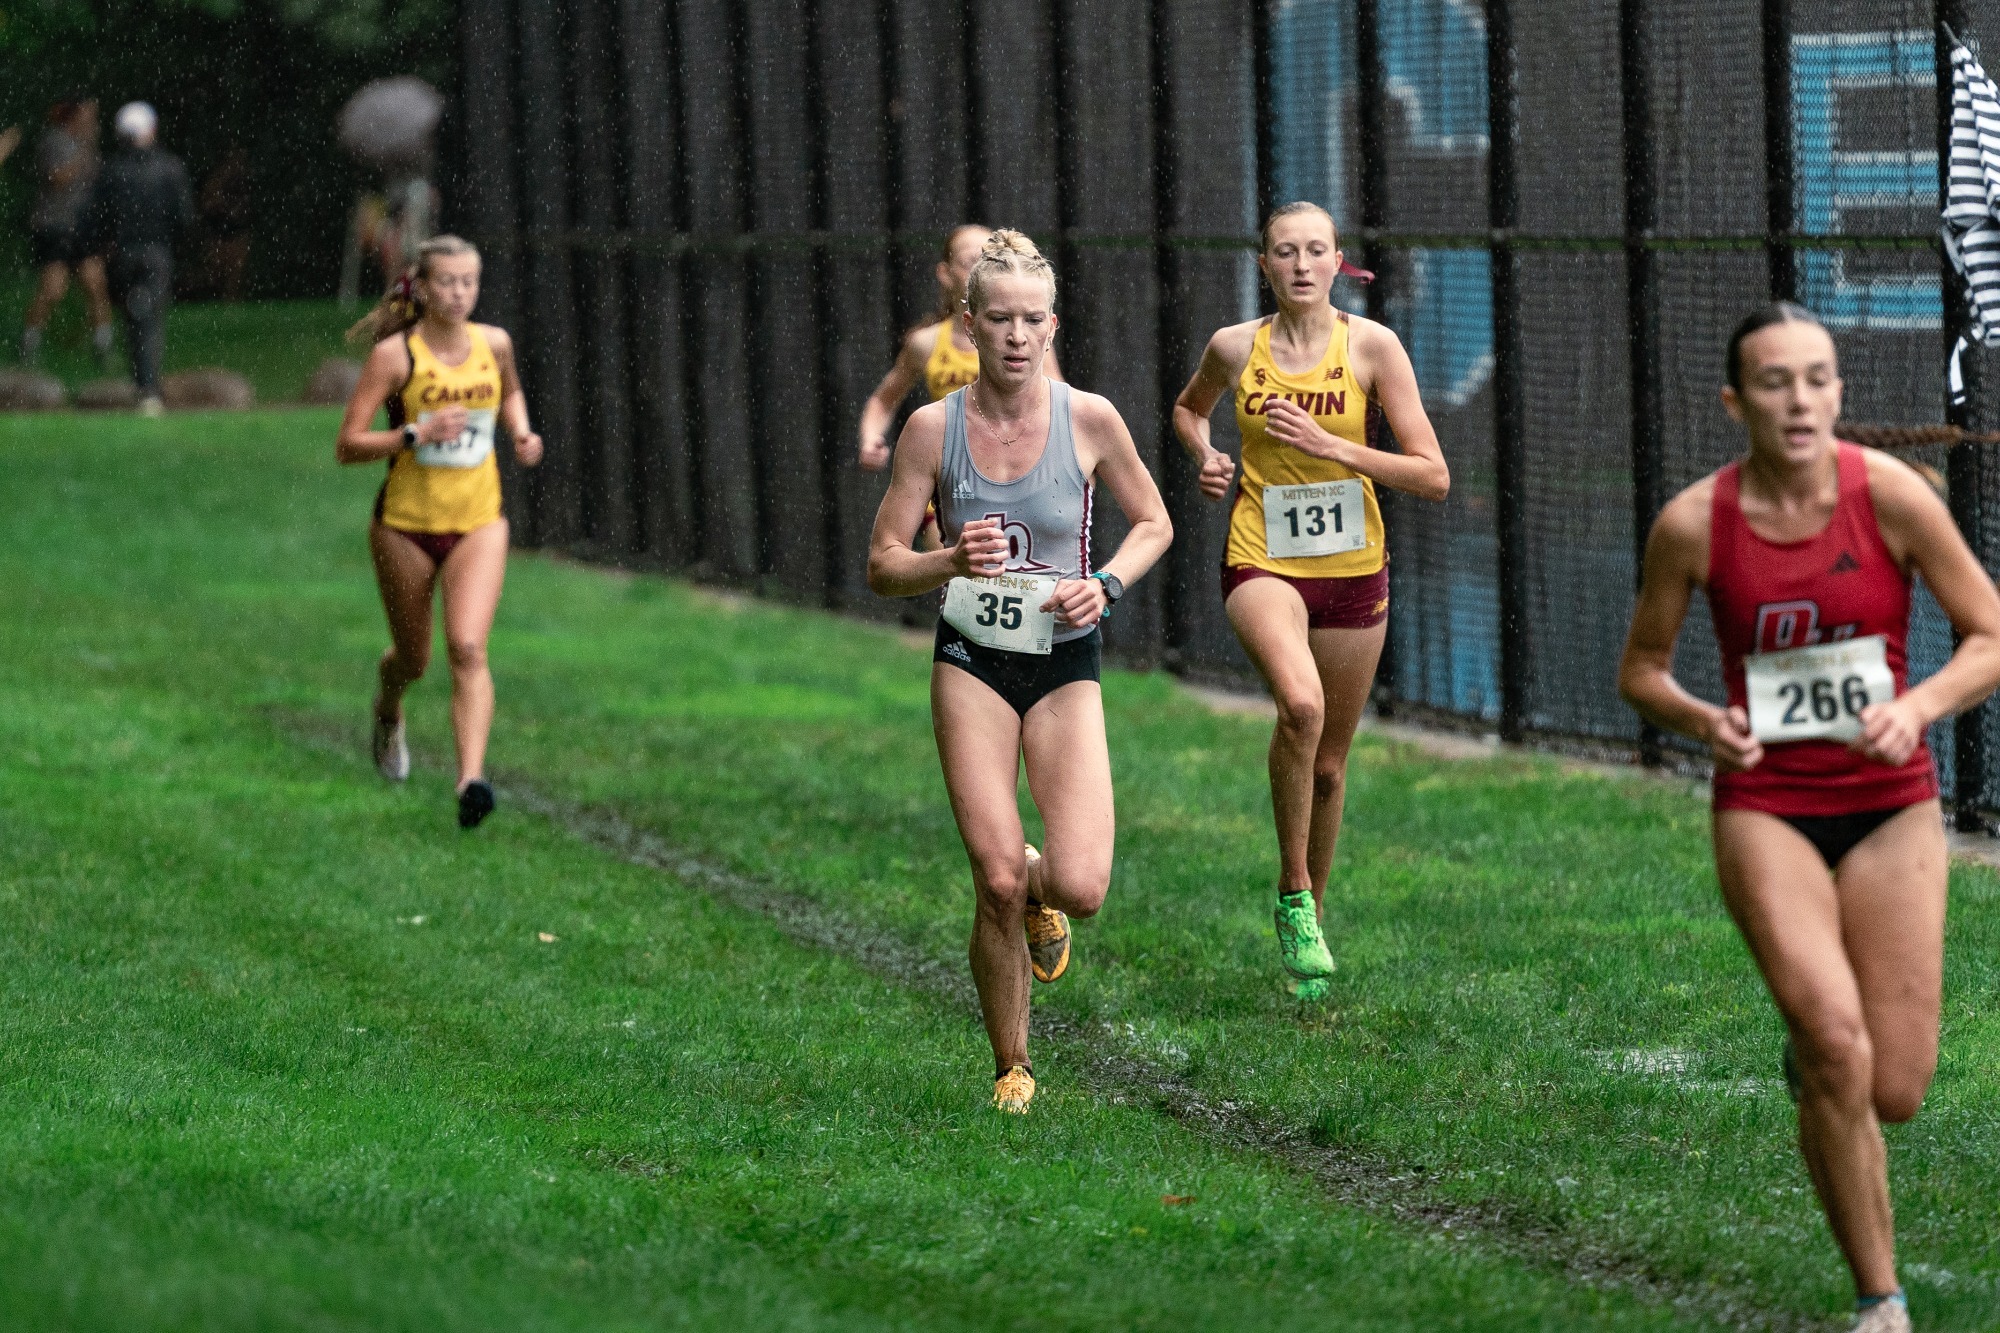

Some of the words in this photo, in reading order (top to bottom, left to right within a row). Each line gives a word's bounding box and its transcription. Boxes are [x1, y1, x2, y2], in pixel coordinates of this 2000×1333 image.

[1244, 391, 1346, 416] CAVIN
[1281, 487, 1326, 500] MITTEN
[1328, 485, 1345, 497] XC
[1284, 502, 1343, 537] 131
[1020, 578, 1039, 591] XC
[976, 592, 1023, 631] 35
[942, 645, 971, 662] adidas
[1777, 674, 1870, 725] 266
